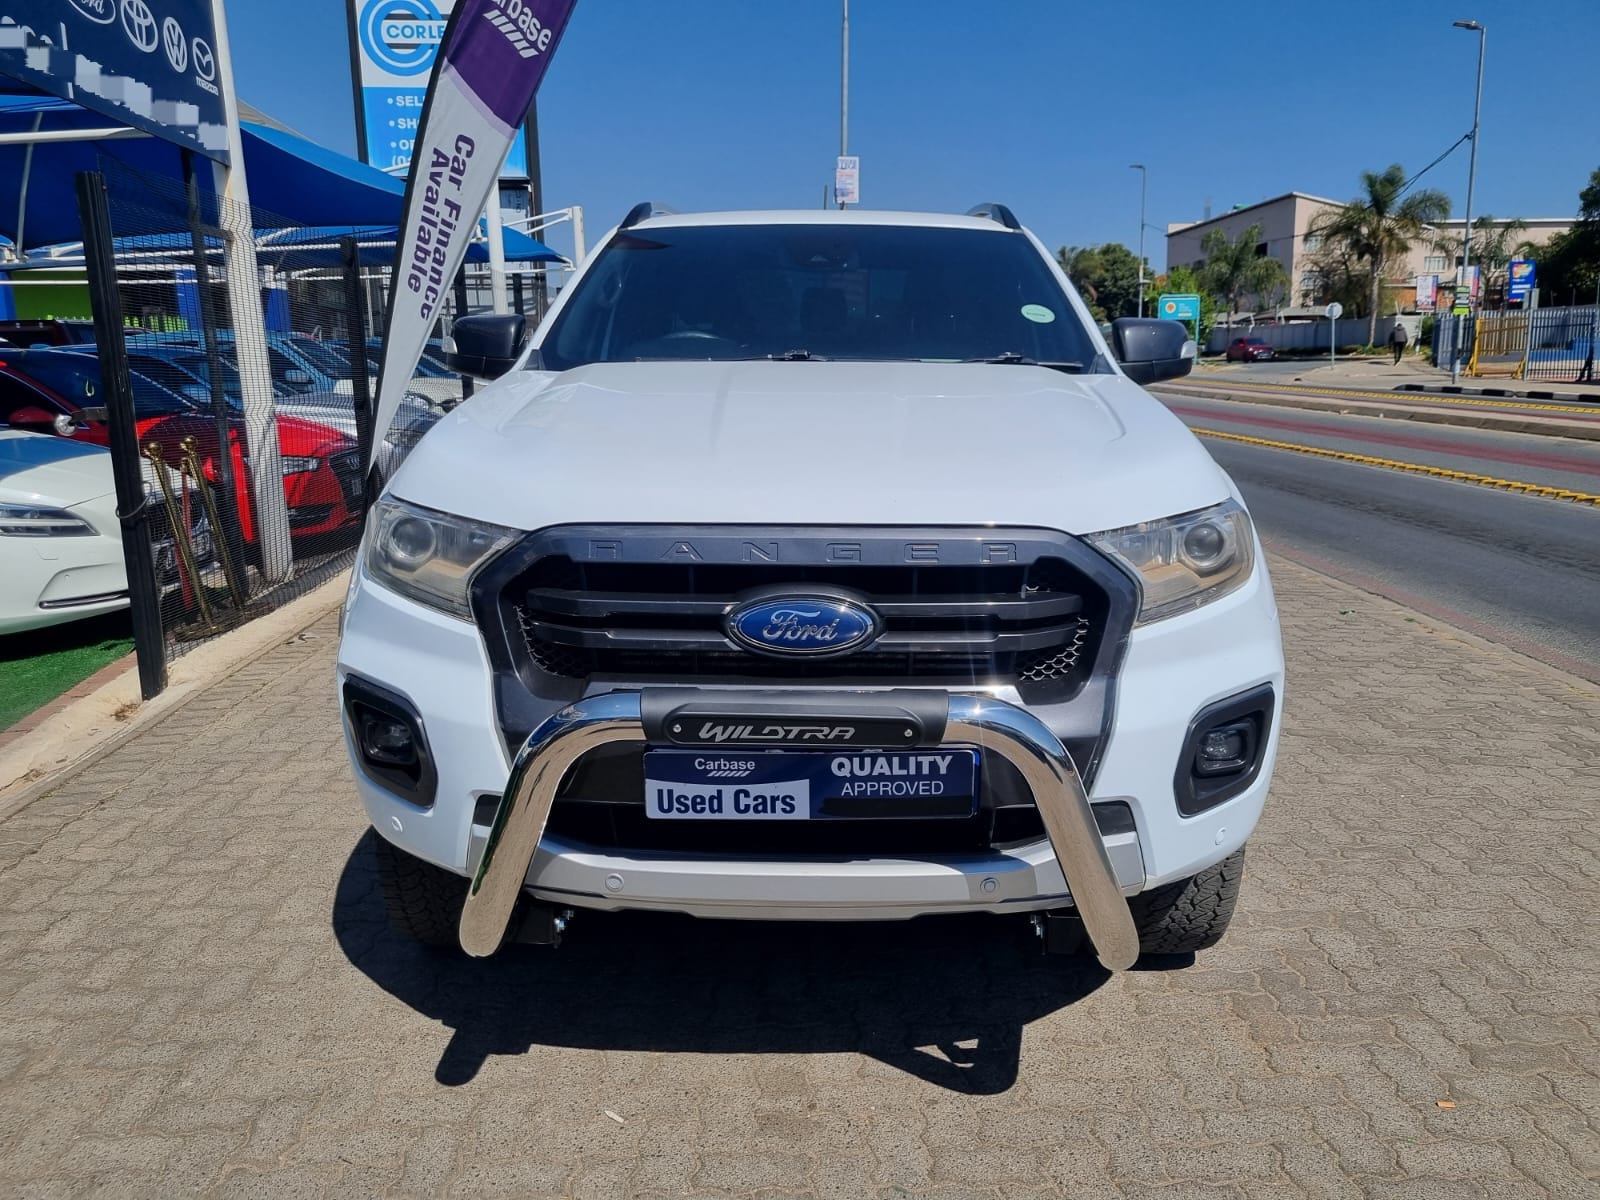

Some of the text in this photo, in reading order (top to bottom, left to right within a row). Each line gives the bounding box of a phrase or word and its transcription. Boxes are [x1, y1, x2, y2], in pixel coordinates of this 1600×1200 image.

[396, 95, 425, 107] SEL
[397, 118, 419, 129] SH
[408, 147, 450, 294] Available
[420, 133, 475, 321] Car Finance
[588, 539, 1018, 564] RANGER
[763, 609, 840, 642] Ford
[694, 758, 756, 770] Carbase
[831, 755, 953, 777] QUALITY
[841, 780, 944, 797] APPROVED
[656, 788, 796, 815] Used Cars
